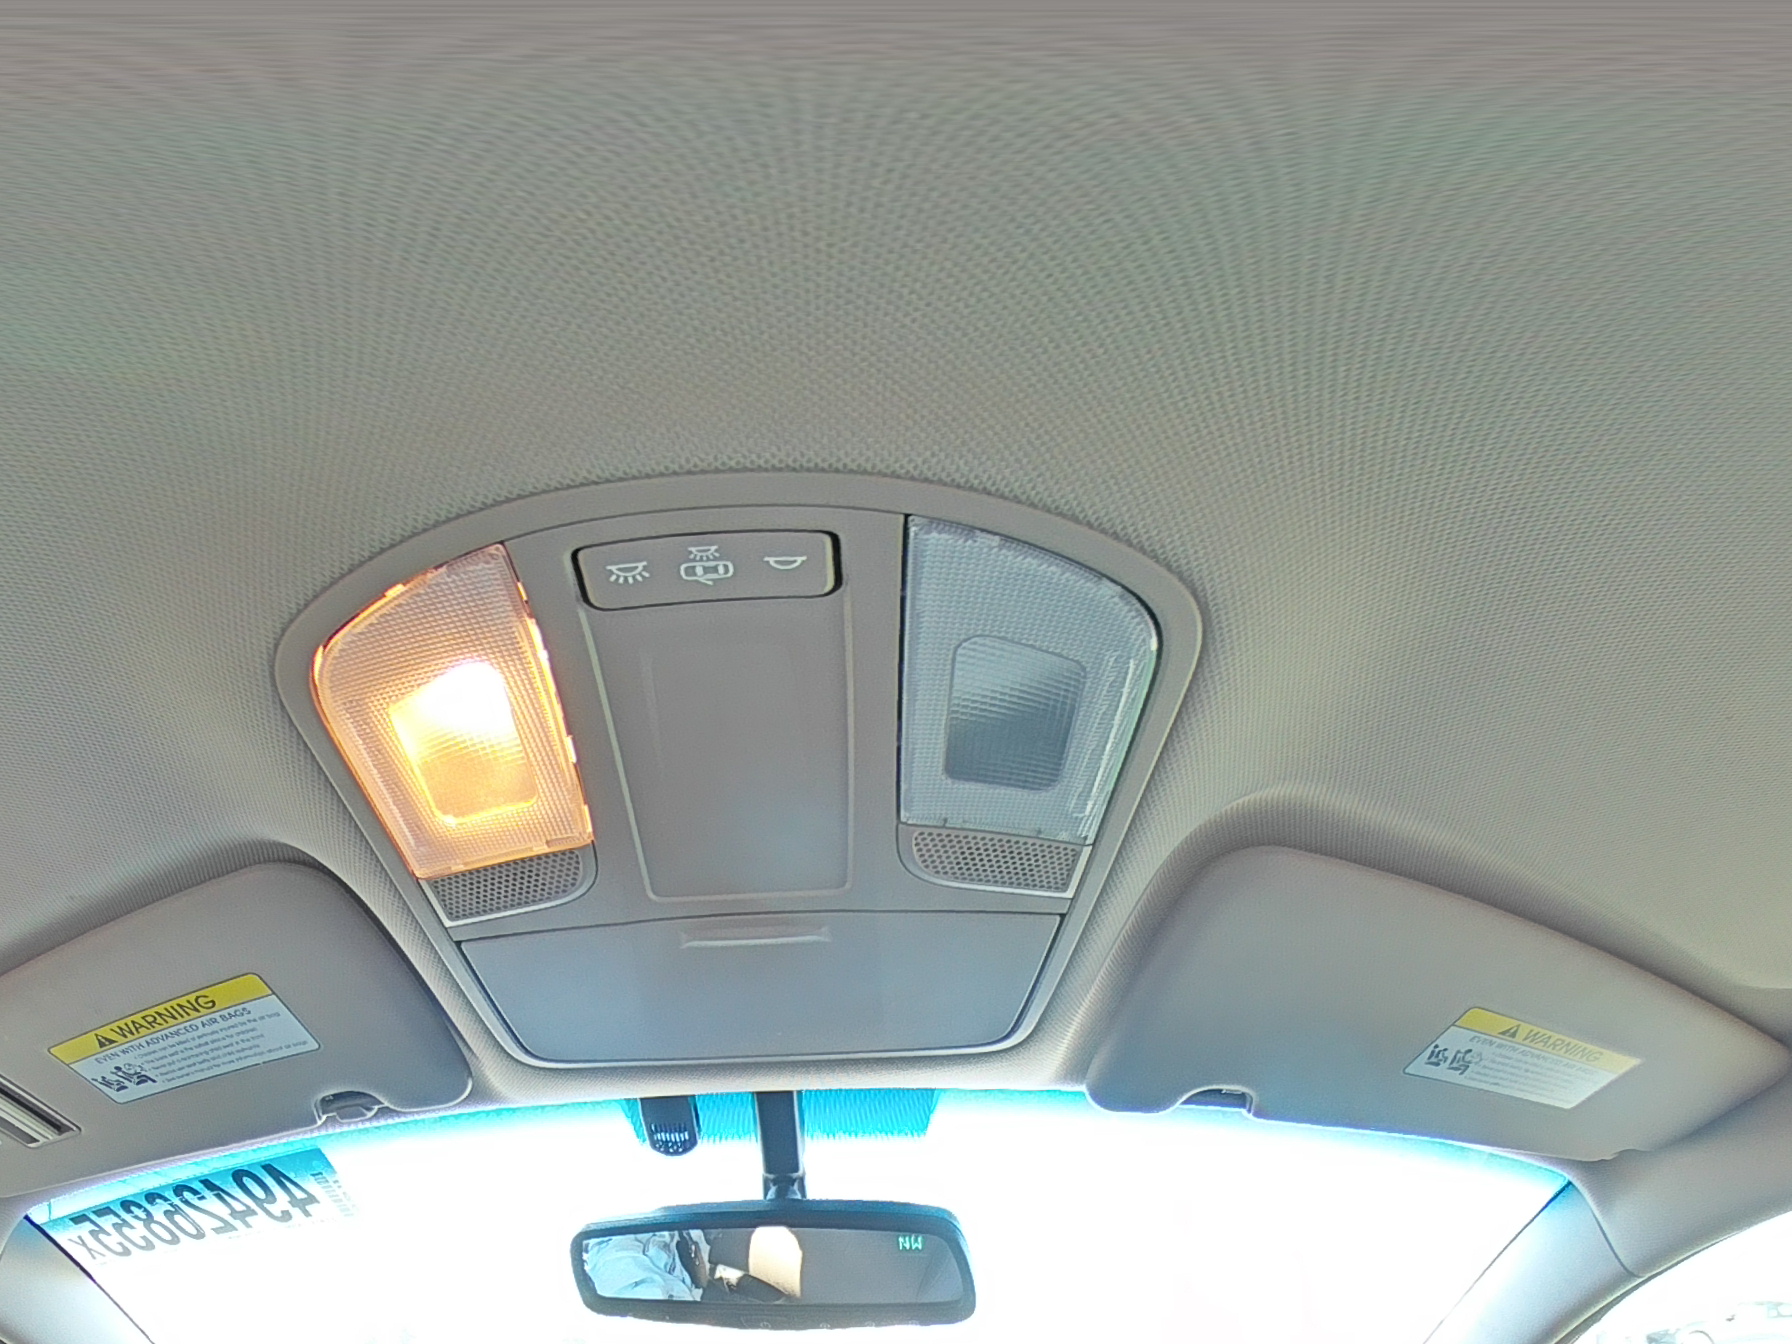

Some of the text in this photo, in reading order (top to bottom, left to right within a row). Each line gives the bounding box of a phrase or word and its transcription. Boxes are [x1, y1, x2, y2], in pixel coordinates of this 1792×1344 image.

[94, 1052, 120, 1065] EVEN
[121, 1042, 144, 1057] WITH
[144, 1023, 199, 1048] ADVANCED
[201, 1016, 219, 1029] AIR
[220, 1007, 252, 1022] BAGS
[110, 994, 216, 1040] WARNING
[1522, 1029, 1603, 1062] WARNING
[898, 1234, 922, 1250] NW
